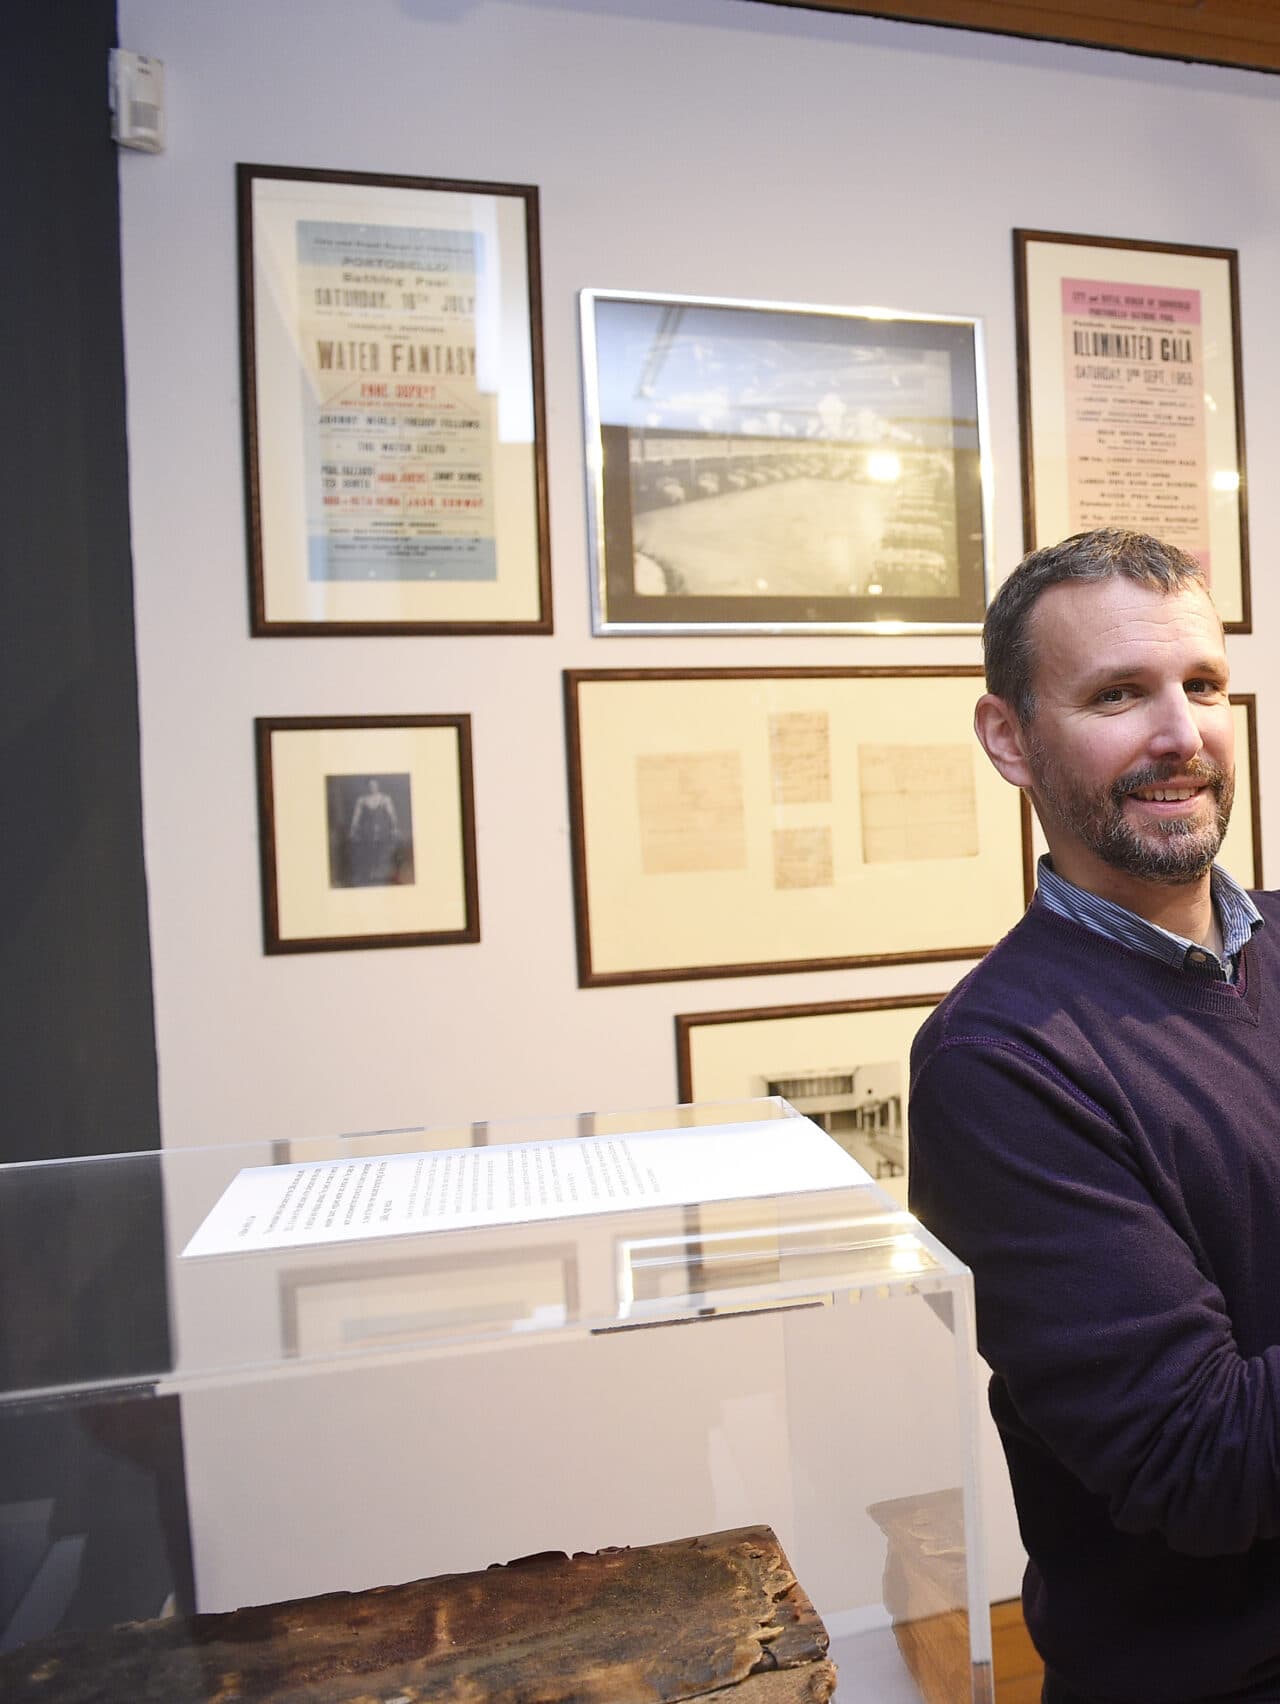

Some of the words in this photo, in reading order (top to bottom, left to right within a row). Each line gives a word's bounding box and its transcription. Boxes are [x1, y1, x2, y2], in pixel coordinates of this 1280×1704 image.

[317, 340, 379, 372] WATER
[390, 343, 475, 375] FANTASY
[1073, 330, 1153, 361] ILLUMINATED
[1160, 337, 1193, 363] GALA
